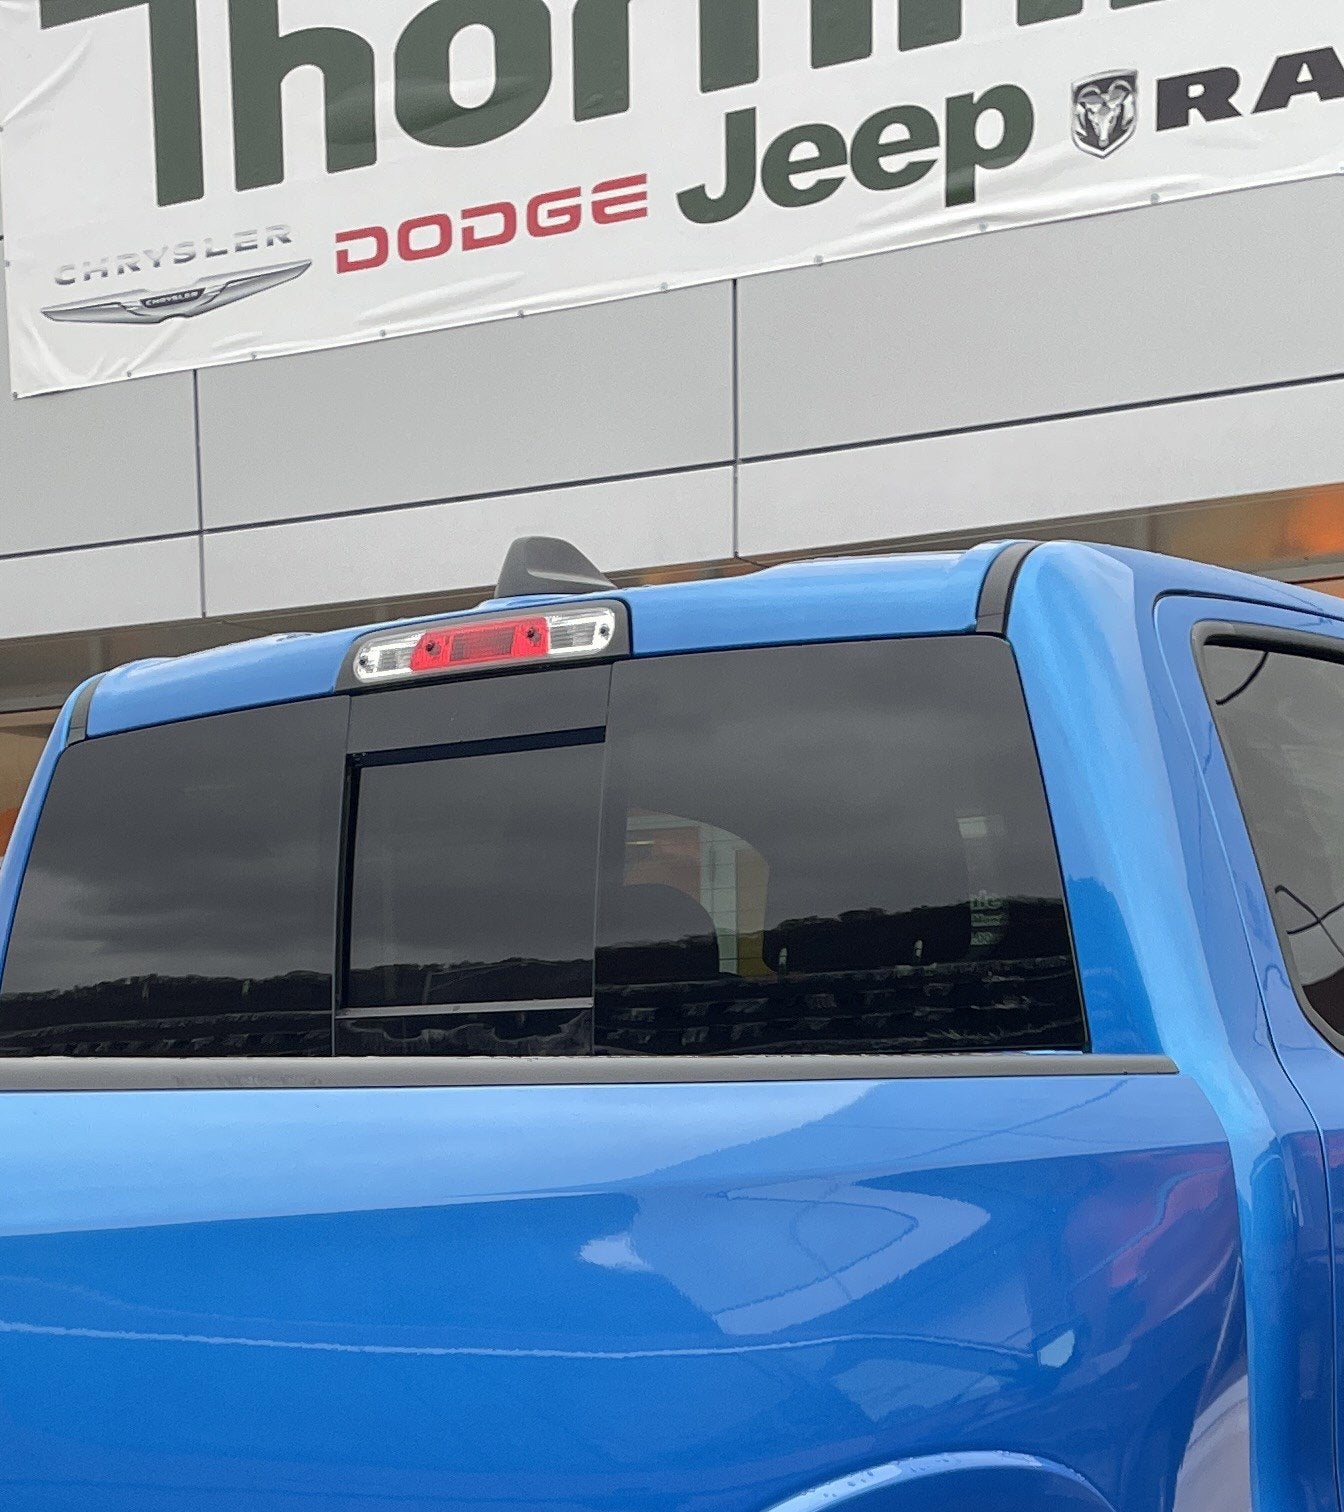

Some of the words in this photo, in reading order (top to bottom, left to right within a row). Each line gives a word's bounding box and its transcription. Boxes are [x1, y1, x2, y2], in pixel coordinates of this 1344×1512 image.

[54, 223, 294, 287] CHRYSLER
[334, 172, 648, 275] DODGE
[676, 82, 1035, 225] Jeep
